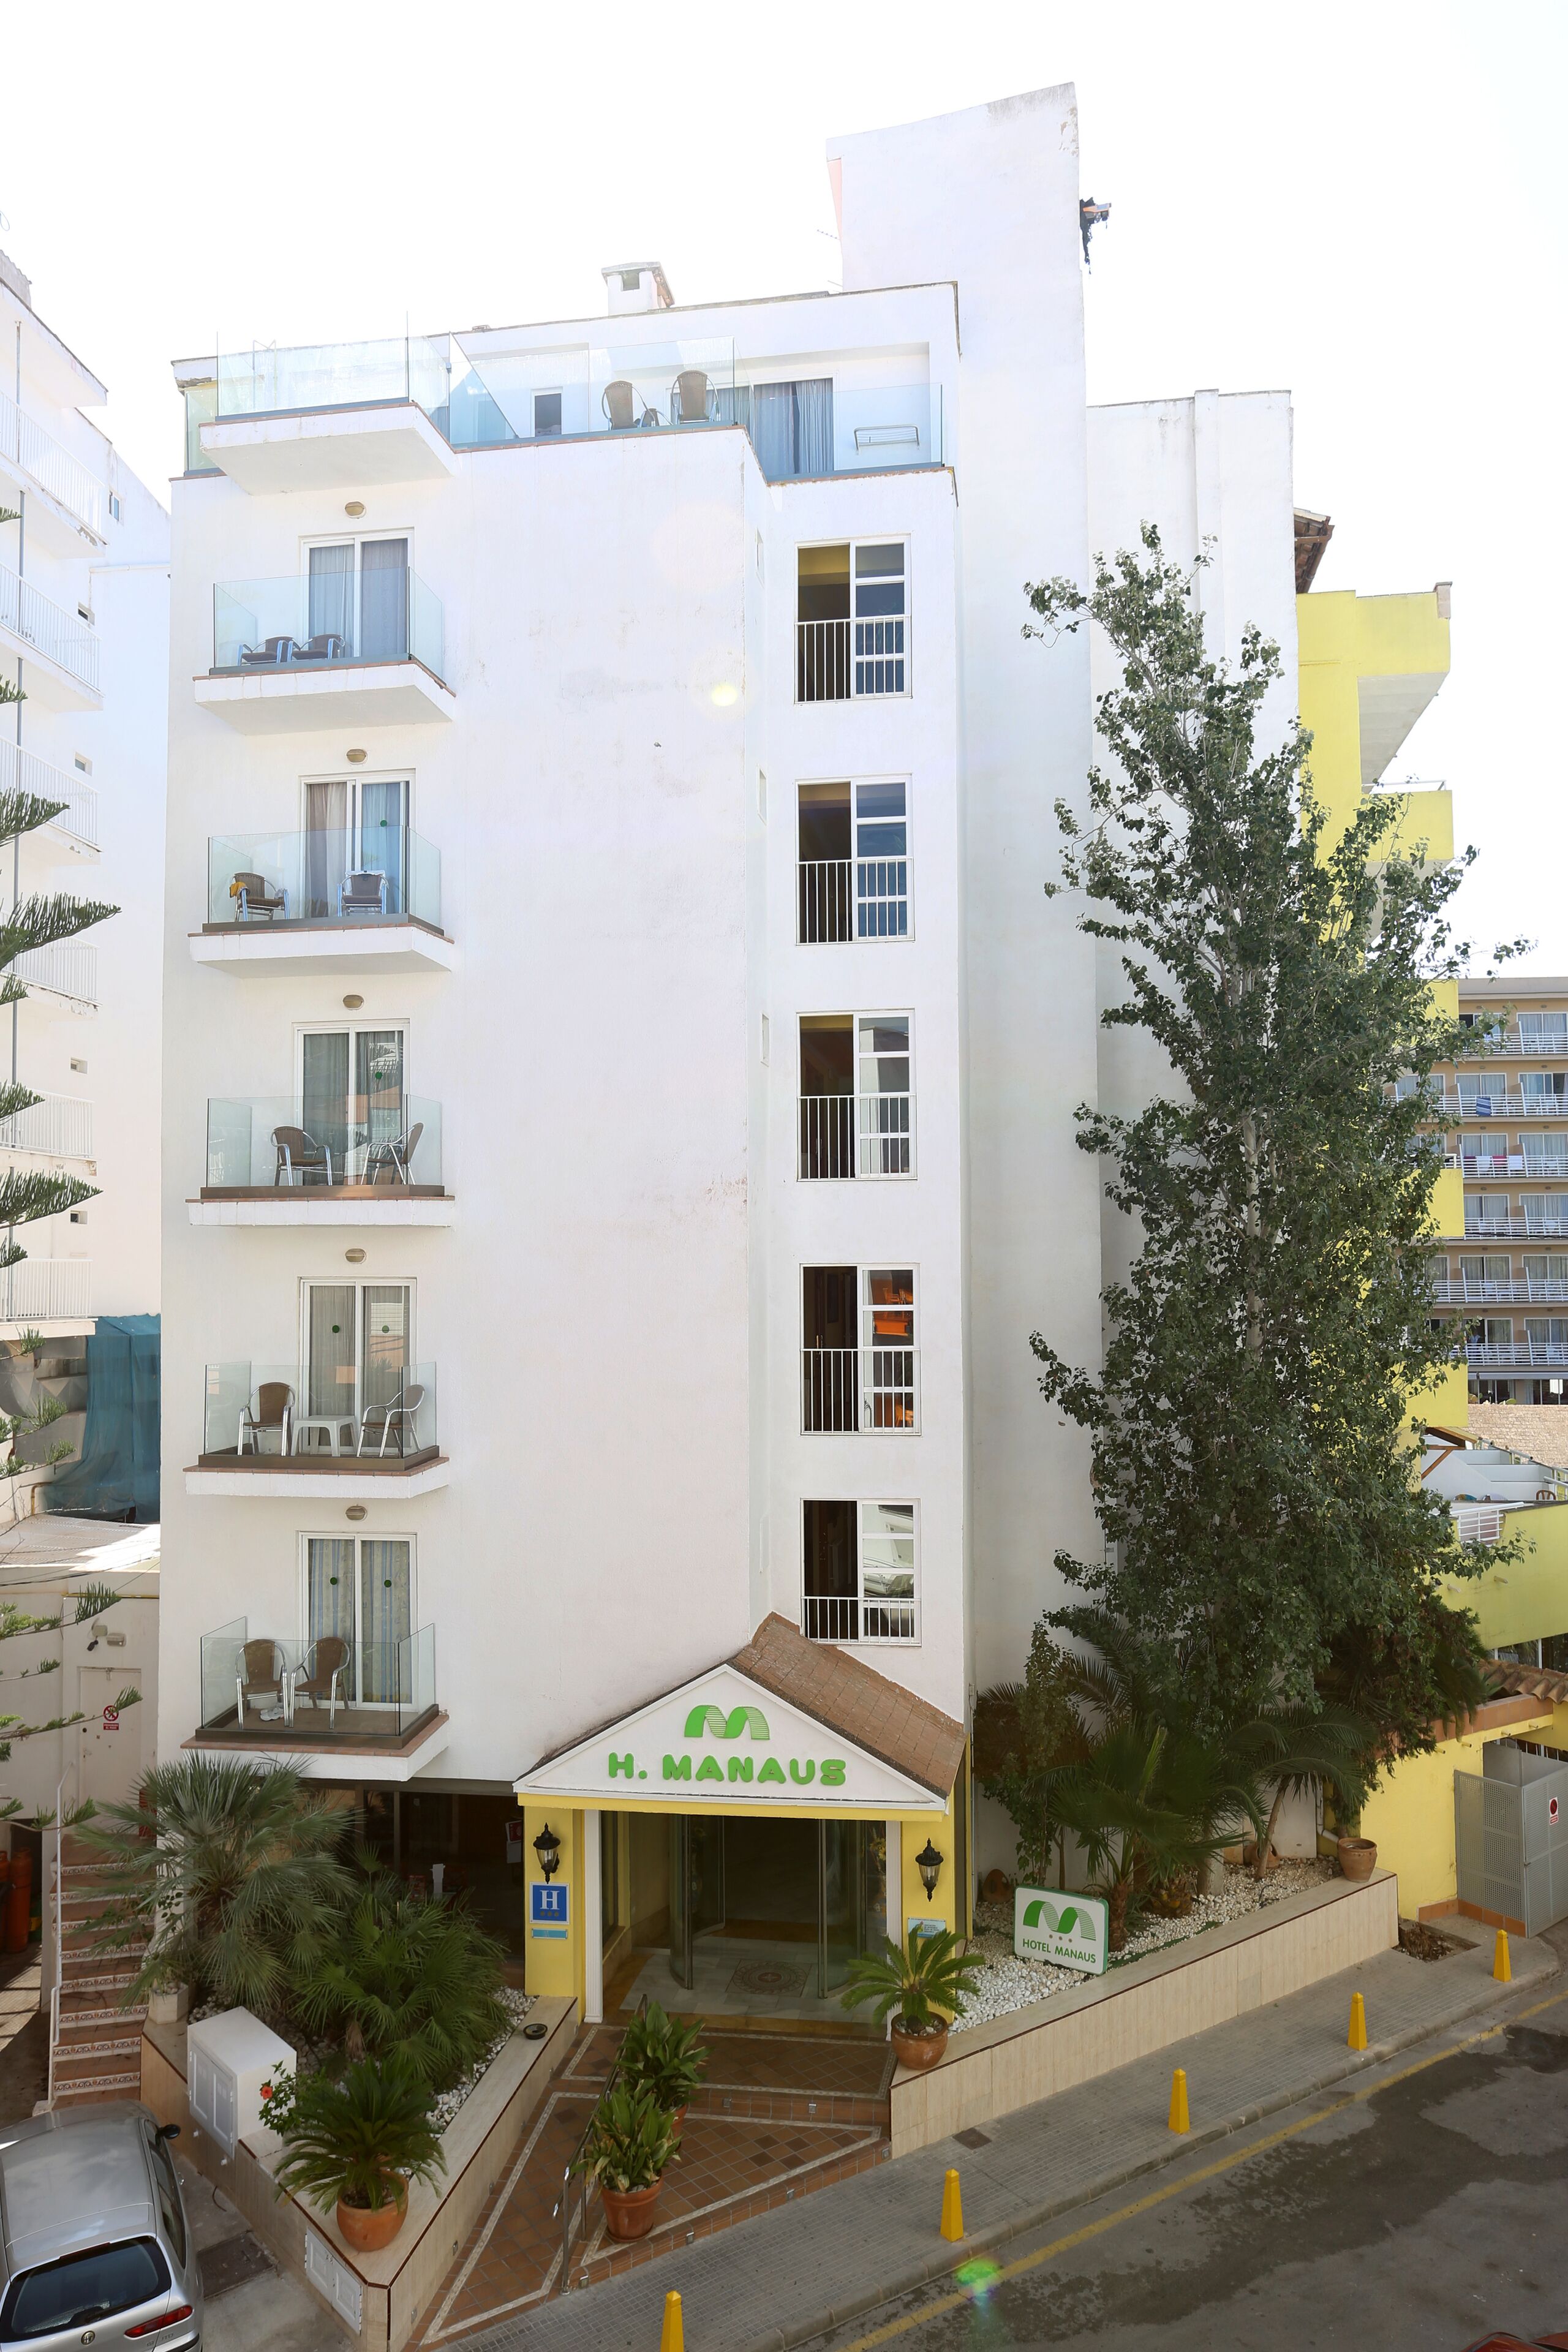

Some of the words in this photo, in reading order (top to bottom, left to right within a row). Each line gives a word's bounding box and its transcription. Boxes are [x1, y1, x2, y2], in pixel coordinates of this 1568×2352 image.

[608, 1752, 647, 1780] H.
[662, 1754, 846, 1786] MANAUS
[540, 1890, 560, 1910] H
[1022, 1938, 1051, 1953] HOTEL
[1055, 1945, 1096, 1964] MANAUS
